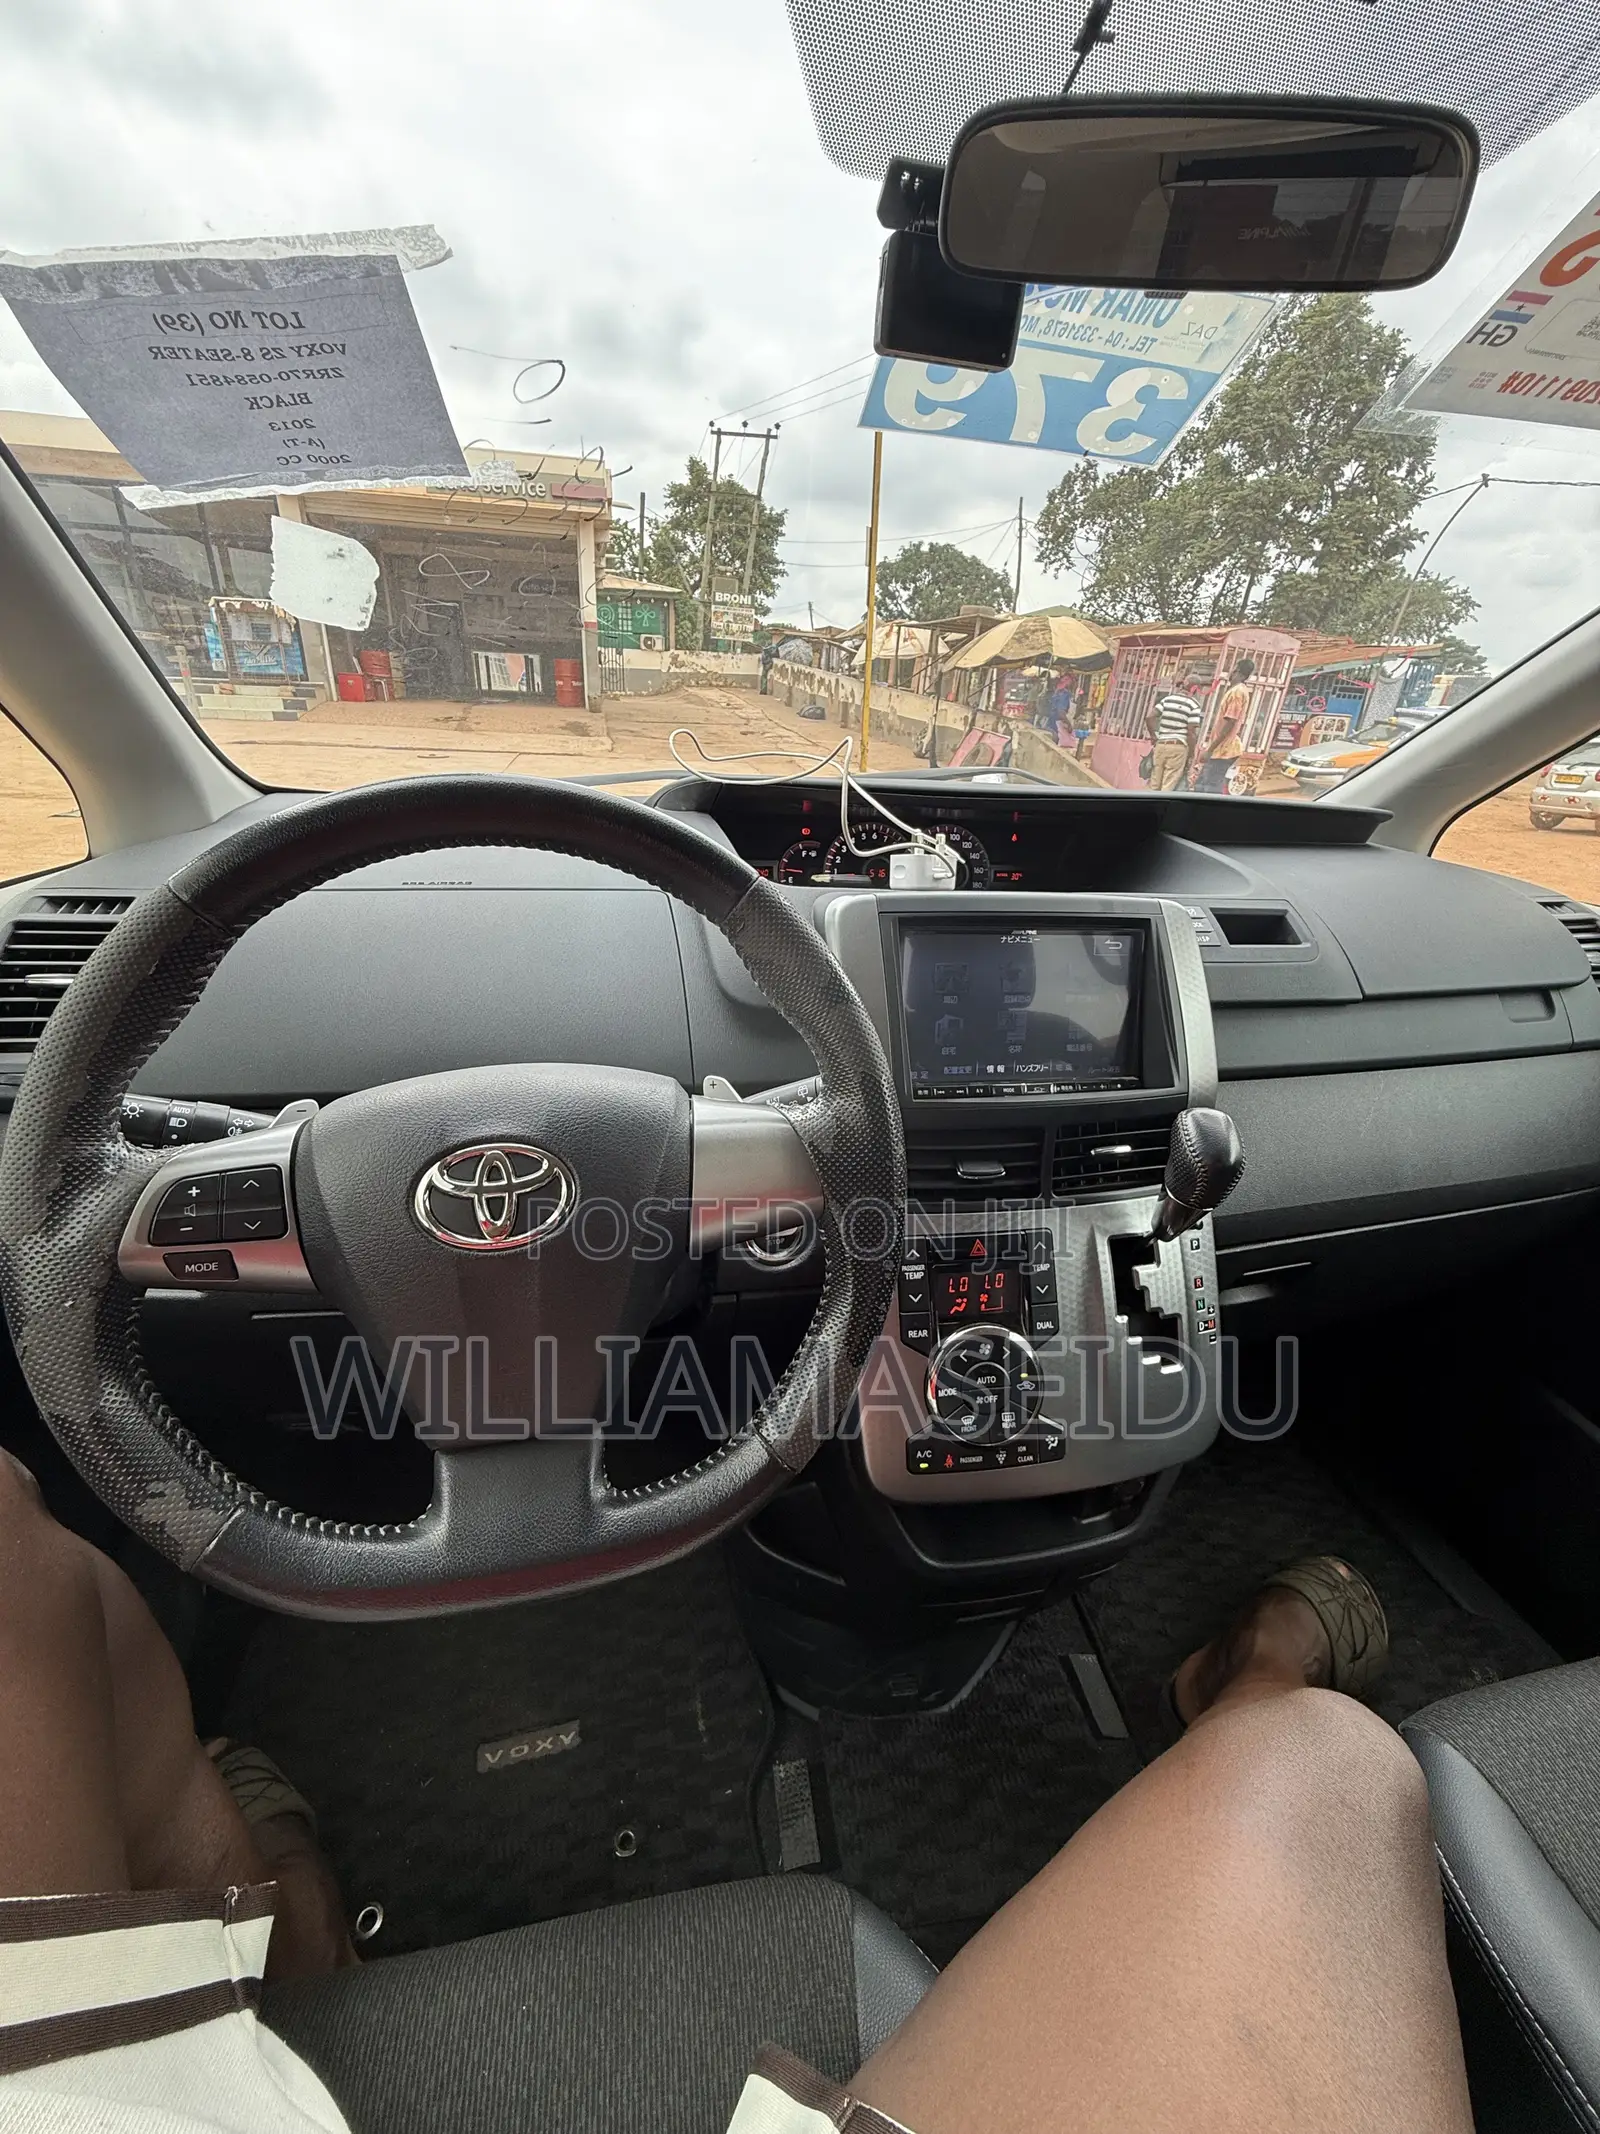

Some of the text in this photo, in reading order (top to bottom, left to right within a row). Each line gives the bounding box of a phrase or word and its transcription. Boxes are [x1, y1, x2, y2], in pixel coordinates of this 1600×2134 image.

[715, 591, 752, 605] BRONI
[861, 832, 867, 840] 5
[883, 835, 889, 843] 7
[802, 850, 808, 858] F
[788, 876, 794, 884] E
[1000, 935, 1041, 943] ナビメニュー
[1016, 1064, 1049, 1072] ハンズフリー
[172, 1106, 191, 1114] AUTO
[184, 1261, 219, 1273] MODE
[1032, 1263, 1051, 1272] TEMP
[904, 1272, 925, 1280] TEMP
[1195, 1278, 1202, 1286] R
[1197, 1301, 1204, 1309] N
[1036, 1320, 1054, 1329] DUAL
[908, 1329, 928, 1338] REAR
[976, 1375, 997, 1384] AUTO
[938, 1388, 958, 1397] MODE
[983, 1395, 998, 1403] OFF
[961, 1424, 977, 1432] FRONT
[1001, 1420, 1017, 1428] REAR
[916, 1450, 933, 1458] A/C
[959, 1455, 983, 1464] PASSENGER
[1017, 1455, 1034, 1463] CLEAN
[484, 1731, 577, 1764] VOXY
